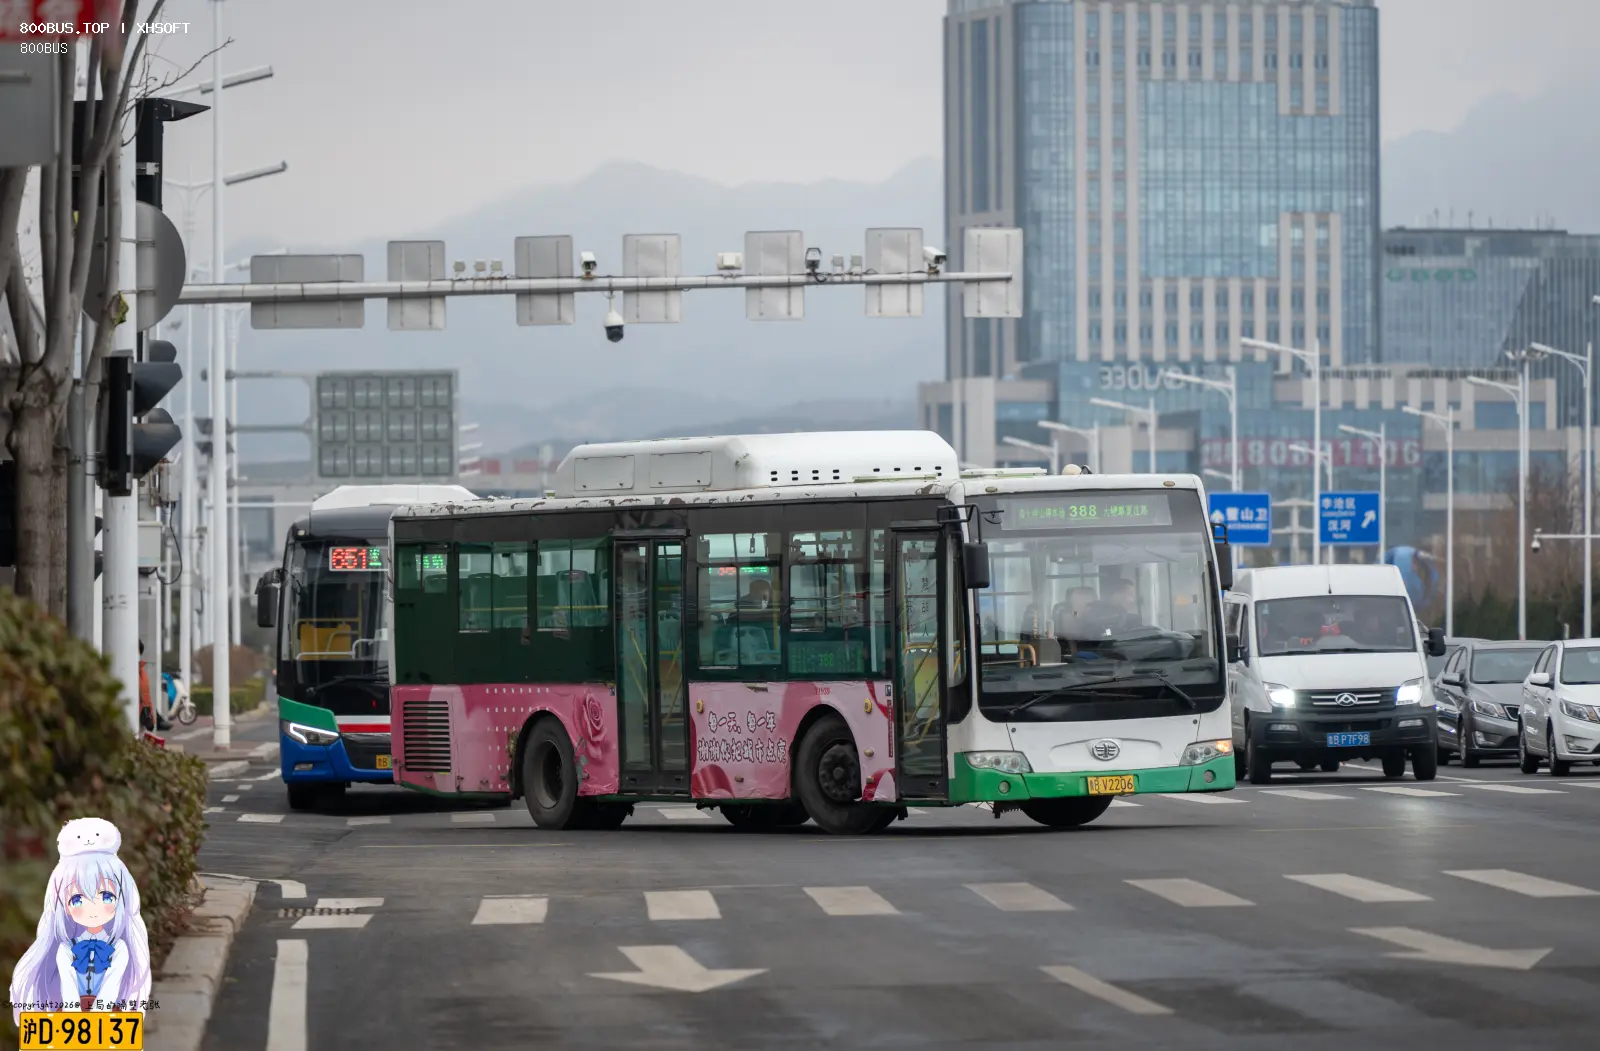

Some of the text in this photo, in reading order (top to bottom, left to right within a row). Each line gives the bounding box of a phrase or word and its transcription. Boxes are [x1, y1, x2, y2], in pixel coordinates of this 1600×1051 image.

[1069, 505, 1098, 518] 388
[698, 738, 787, 763] 谢谢你把城市点亮
